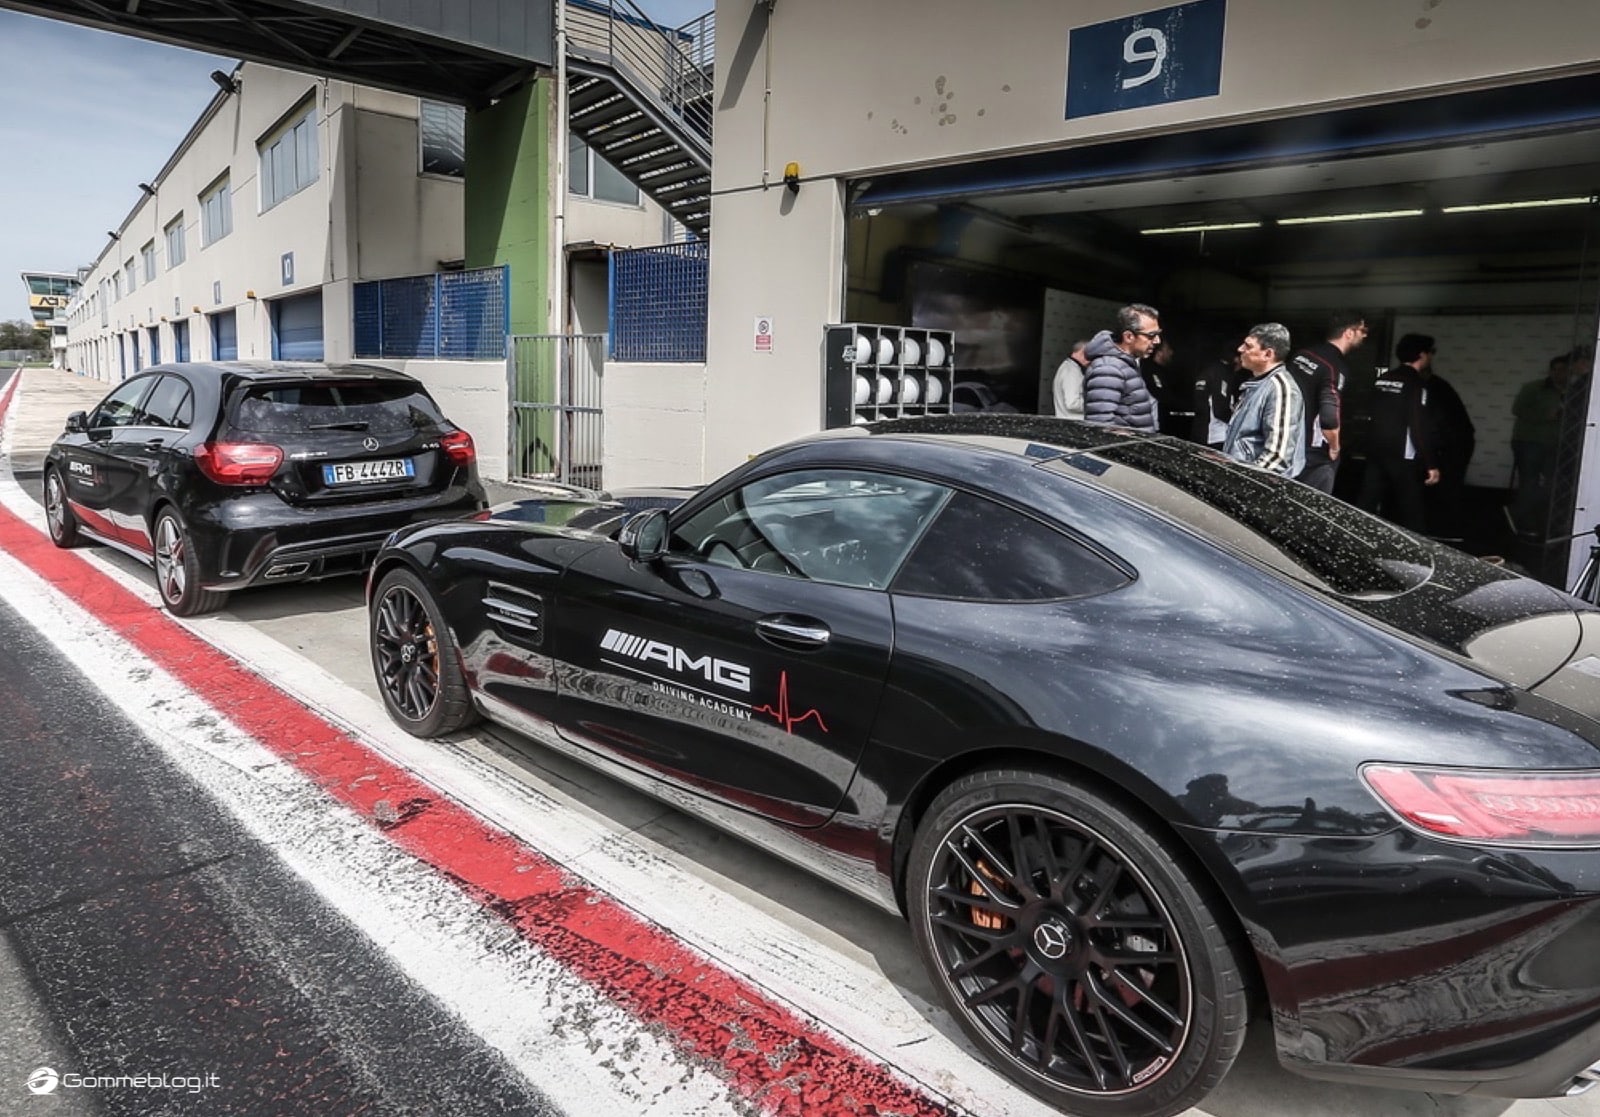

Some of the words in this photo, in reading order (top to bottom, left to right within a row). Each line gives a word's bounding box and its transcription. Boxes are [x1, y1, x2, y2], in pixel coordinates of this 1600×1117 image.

[1121, 27, 1167, 90] 9
[335, 466, 355, 481] FB
[360, 461, 405, 479] 444ZR
[640, 639, 751, 692] AMG
[652, 681, 695, 703] DRIVING
[699, 696, 752, 722] ACADEMY
